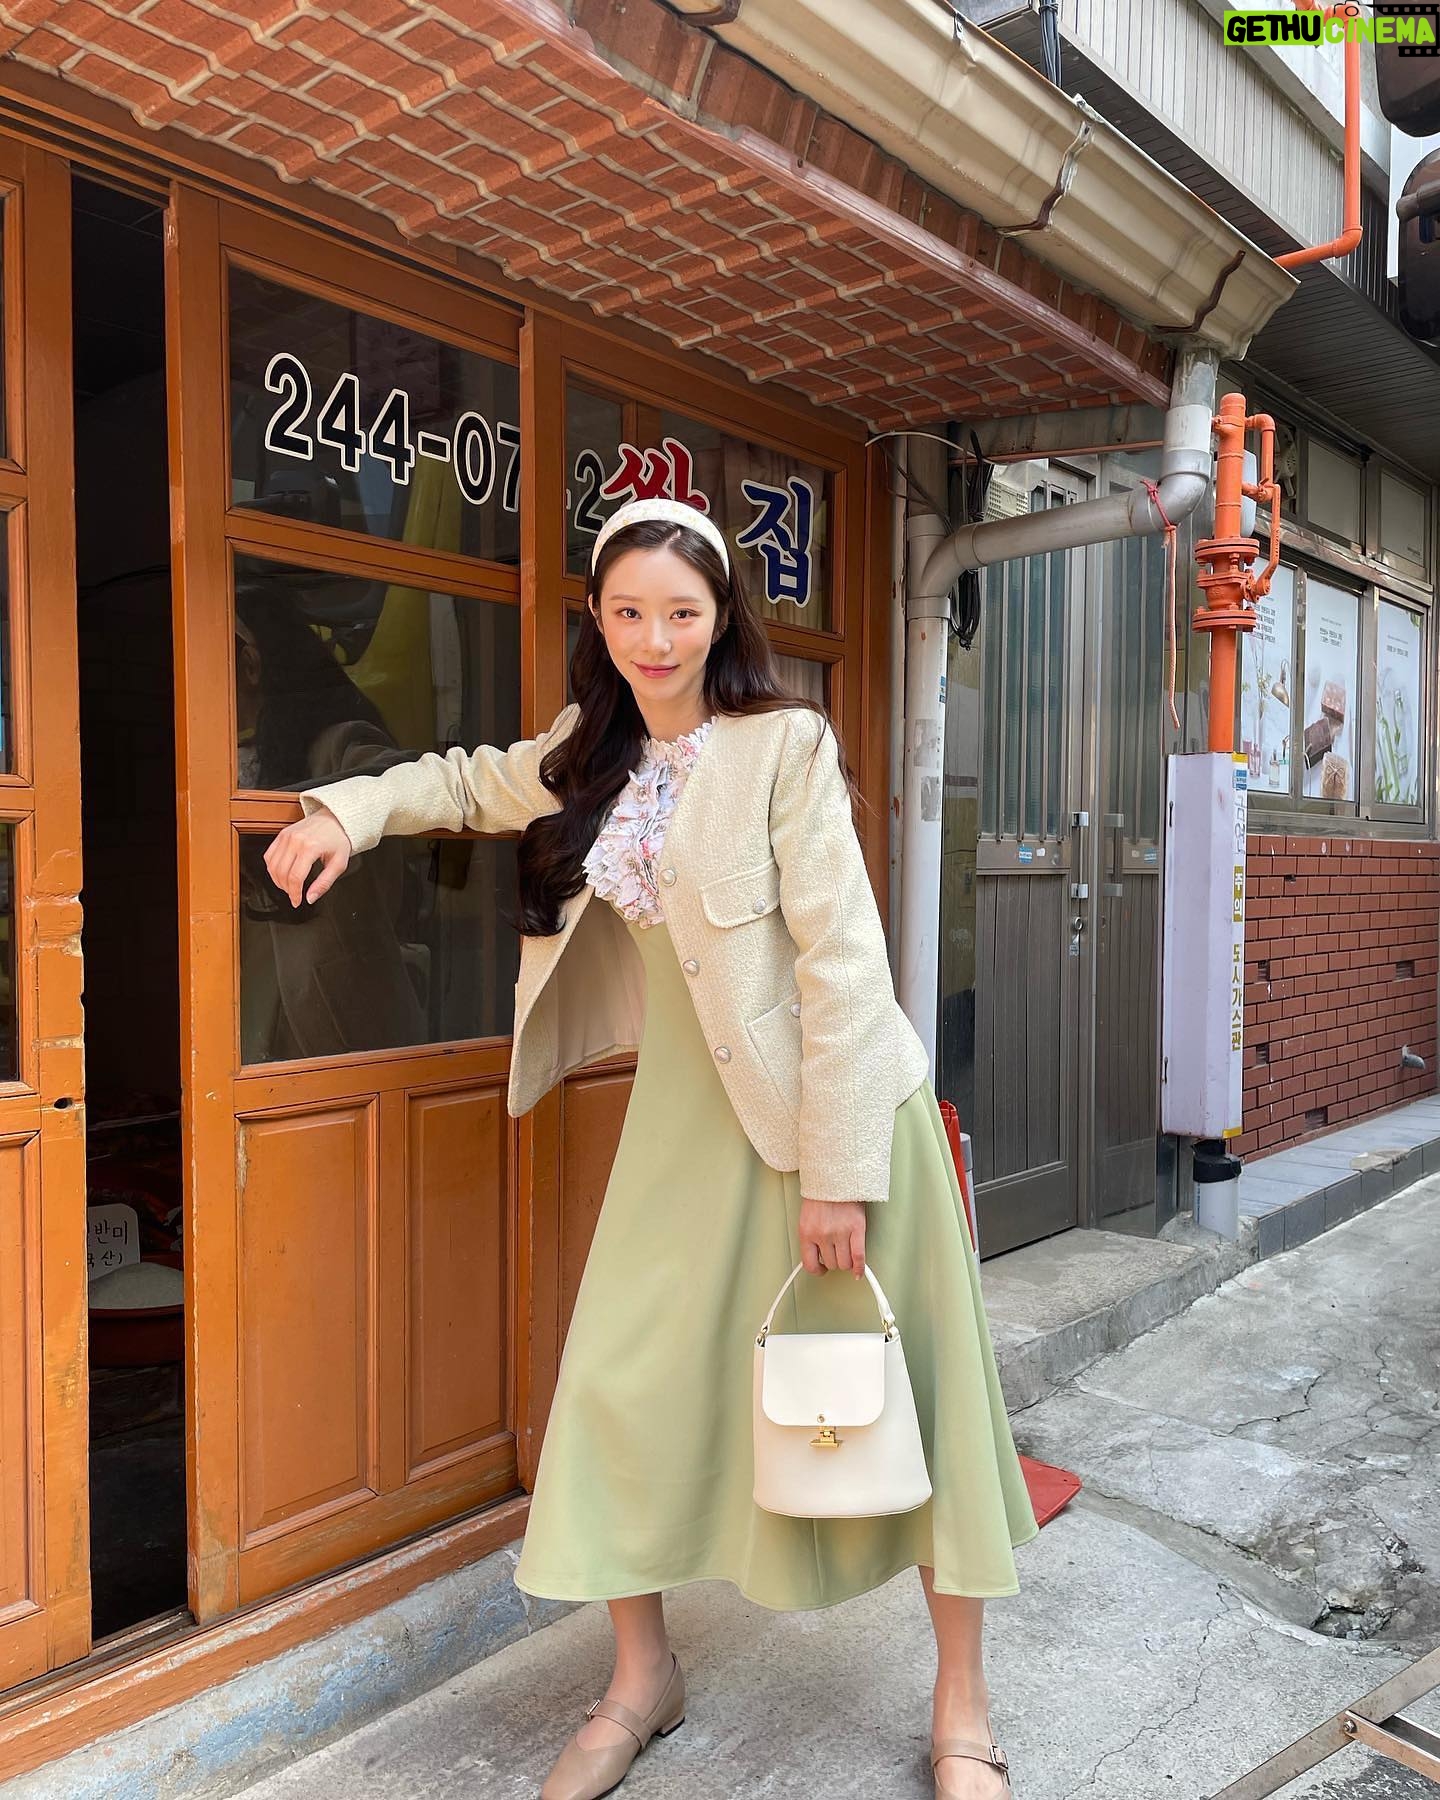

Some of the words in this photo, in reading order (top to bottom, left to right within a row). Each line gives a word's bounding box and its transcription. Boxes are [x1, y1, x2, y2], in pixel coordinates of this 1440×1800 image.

[566, 449, 606, 535] 2
[1234, 873, 1243, 917] 주의
[1232, 944, 1242, 1051] 도시가스관
[88, 1219, 128, 1246] 반미
